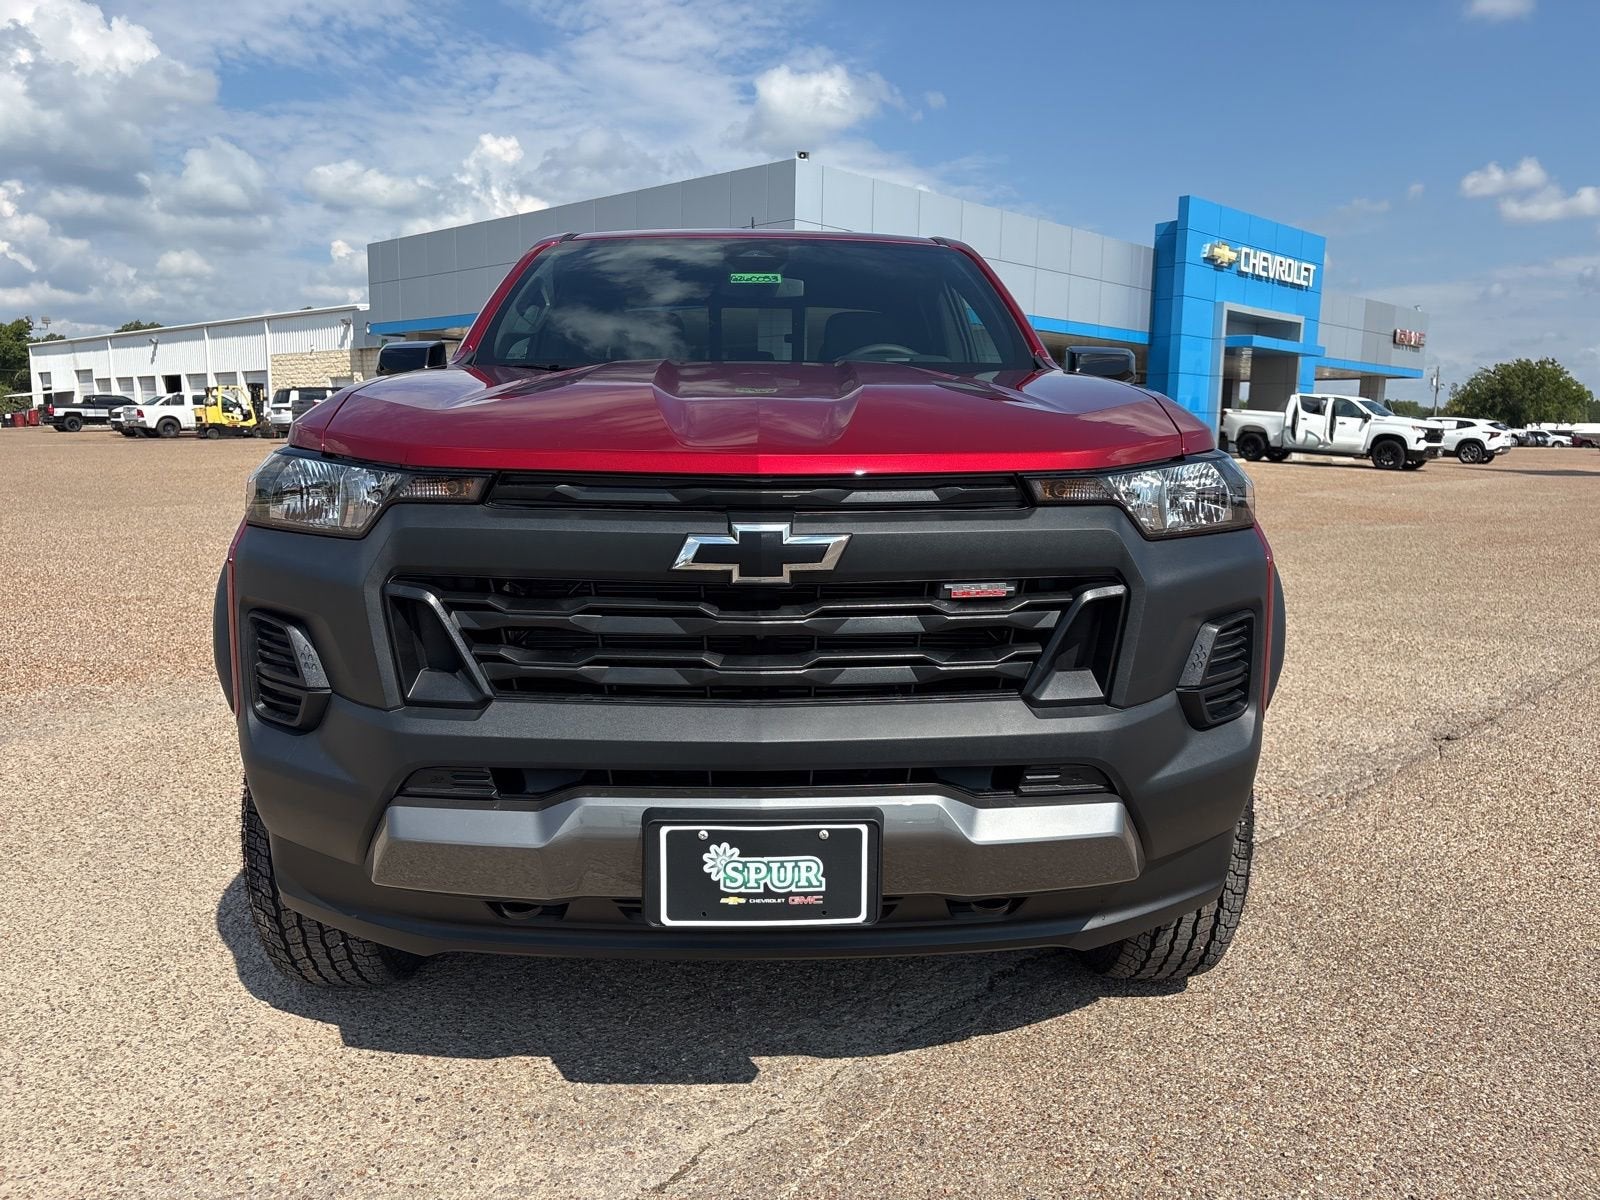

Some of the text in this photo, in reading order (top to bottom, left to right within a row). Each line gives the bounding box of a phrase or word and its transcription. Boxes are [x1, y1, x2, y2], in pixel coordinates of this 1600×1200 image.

[1239, 246, 1317, 288] CHEVROLET
[722, 857, 824, 891] SPUR
[788, 895, 823, 905] GMC
